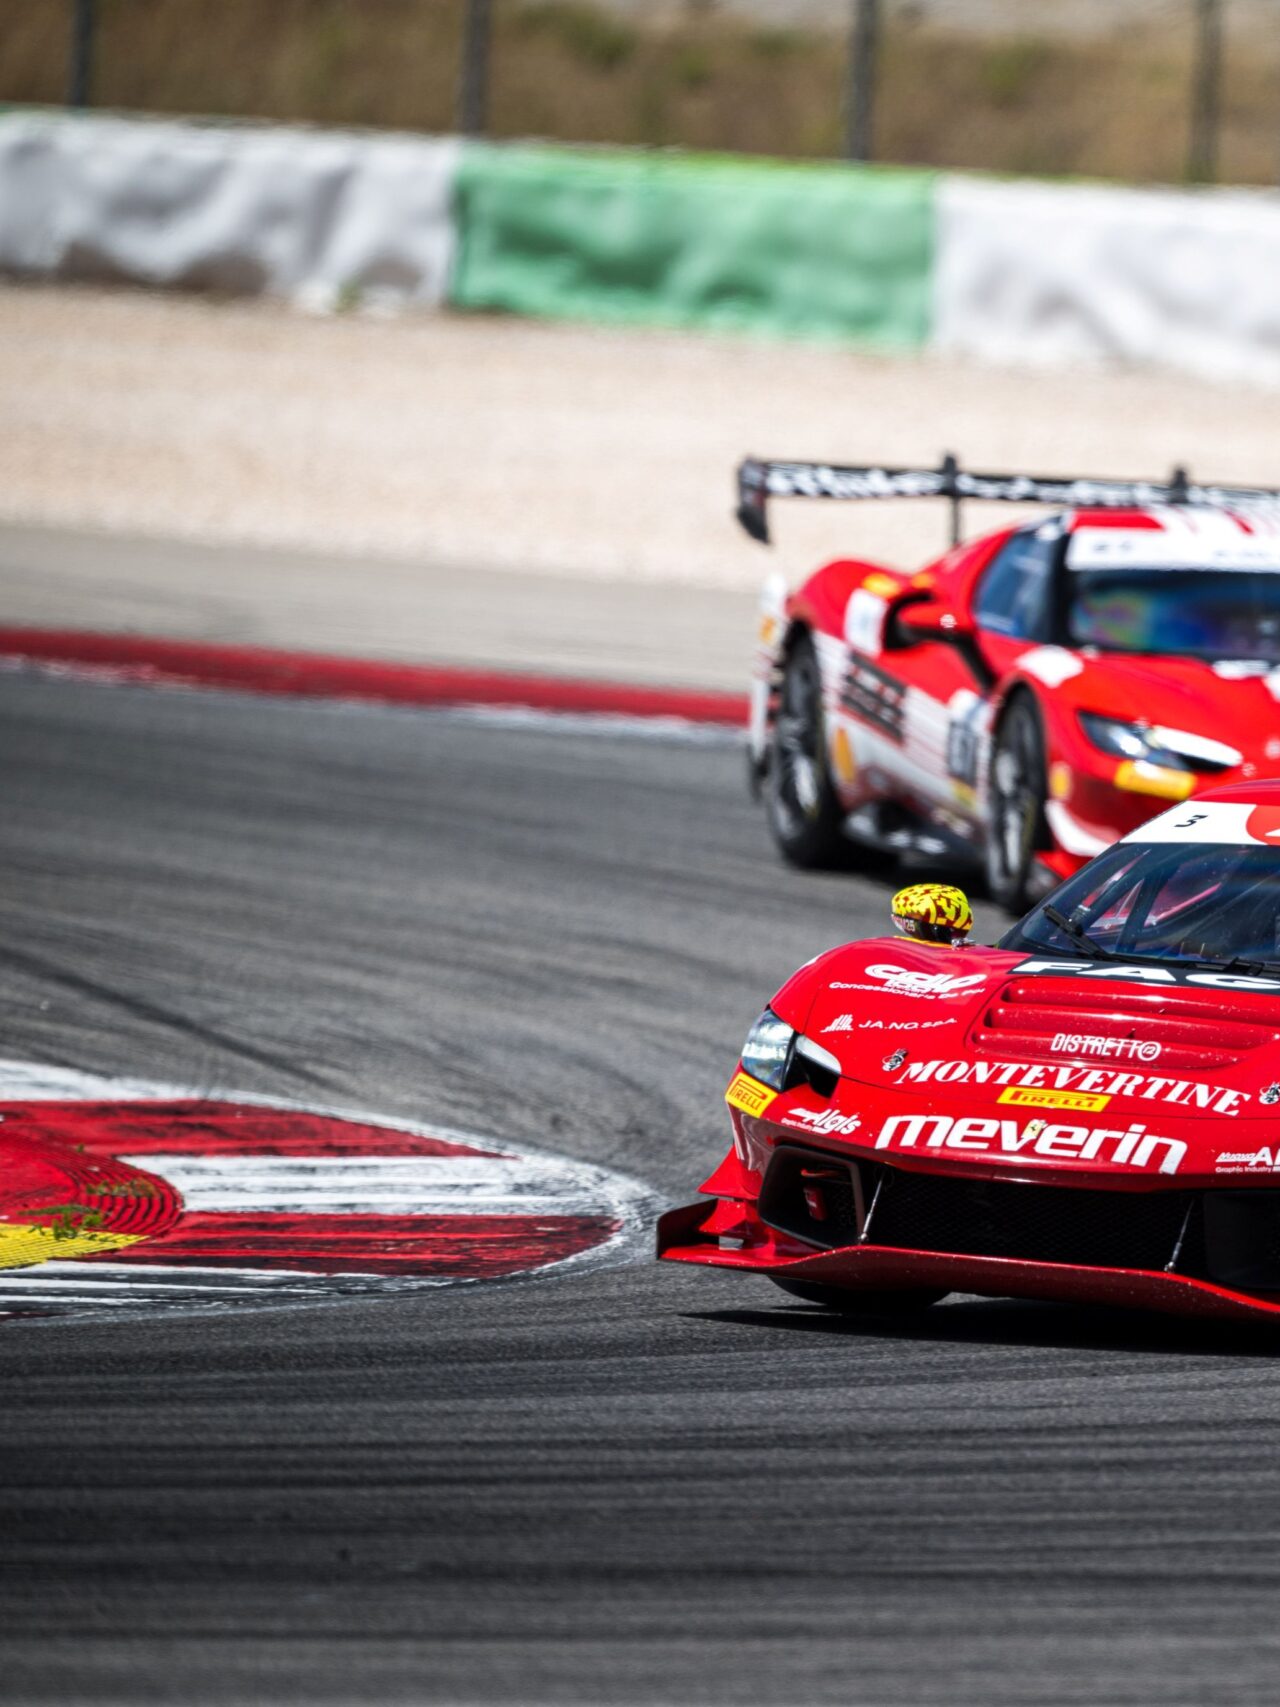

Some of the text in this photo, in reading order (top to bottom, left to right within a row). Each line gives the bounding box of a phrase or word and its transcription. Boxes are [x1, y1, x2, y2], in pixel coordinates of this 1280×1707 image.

[1173, 814, 1208, 828] 3
[728, 1079, 768, 1111] PIRELLI
[893, 1059, 1252, 1116] MONTEVERTINE
[1009, 1089, 1098, 1109] PIRELLI
[874, 1114, 1188, 1175] meverin
[1215, 1165, 1272, 1174] Graphic Industry
